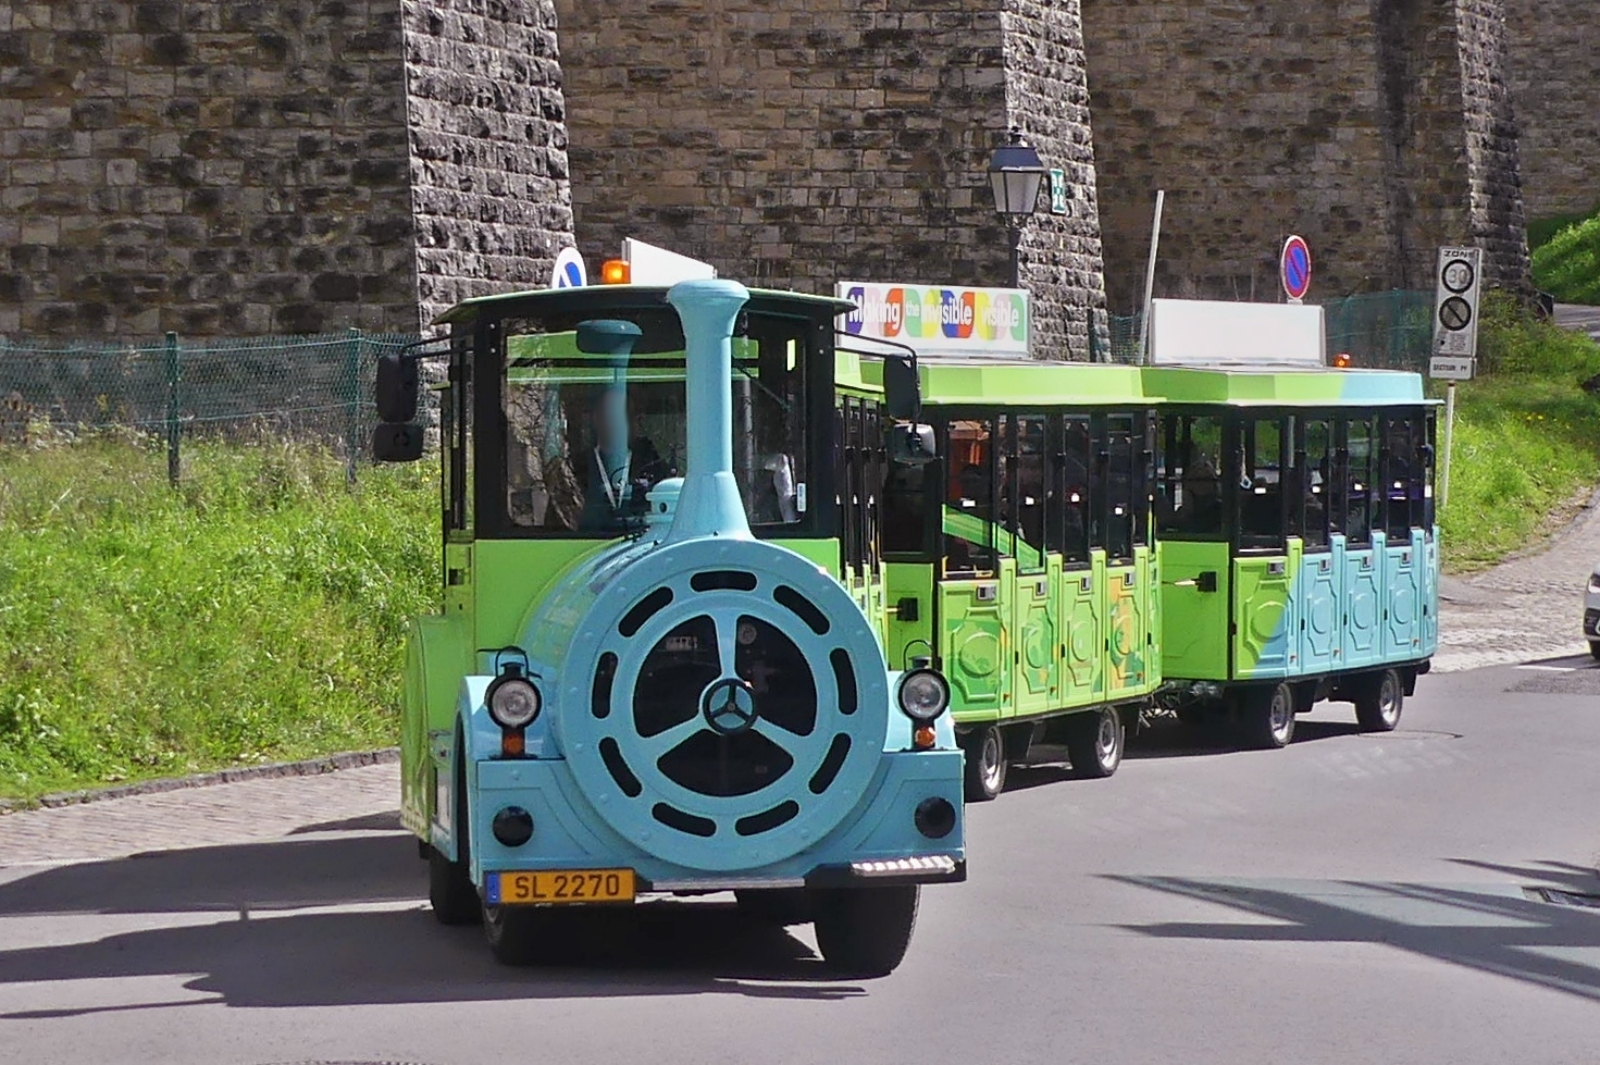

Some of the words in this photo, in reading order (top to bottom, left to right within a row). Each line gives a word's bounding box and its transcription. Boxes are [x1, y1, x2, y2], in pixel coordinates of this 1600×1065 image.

[1448, 268, 1468, 284] 30
[849, 295, 900, 330] Making
[905, 301, 919, 317] the
[515, 875, 546, 898] SL
[554, 874, 619, 897] 2270
